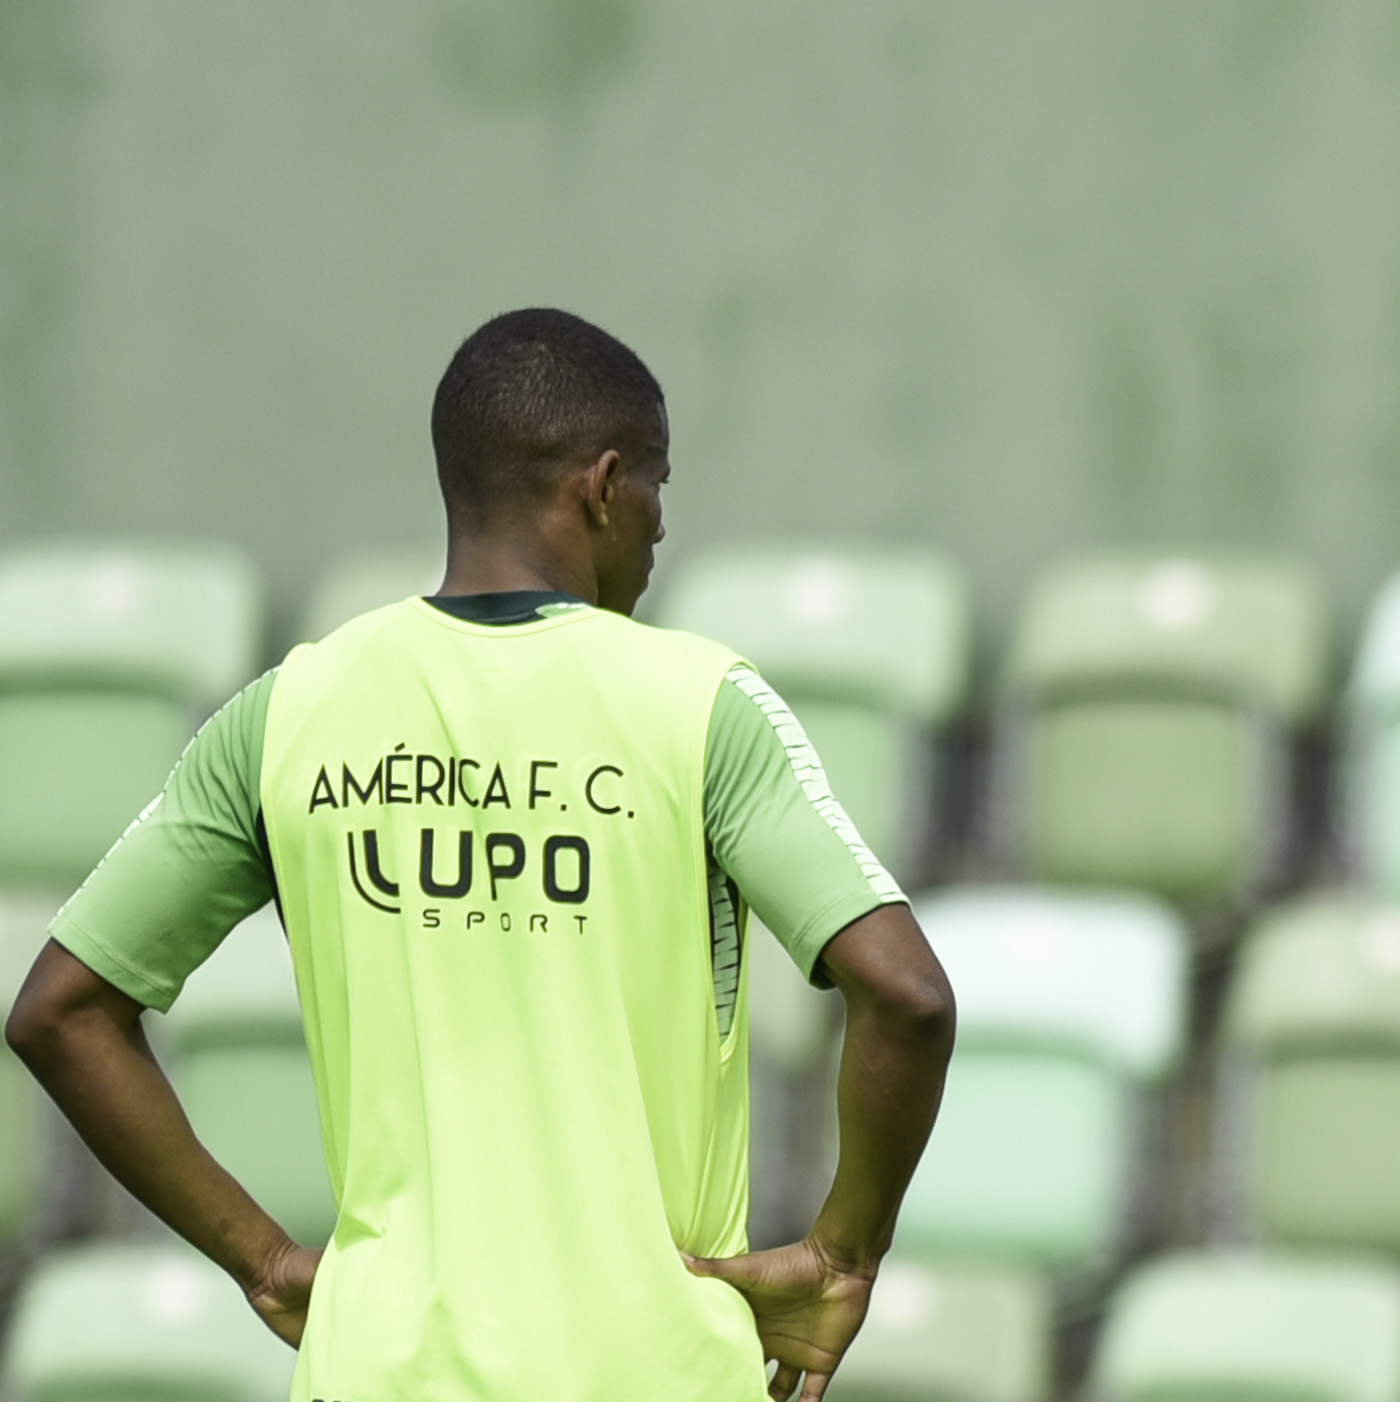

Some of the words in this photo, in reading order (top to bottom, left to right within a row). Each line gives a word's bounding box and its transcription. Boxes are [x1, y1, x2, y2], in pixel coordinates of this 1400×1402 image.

[308, 742, 511, 815] AMÉRICA
[347, 828, 590, 914] LUPO
[422, 908, 588, 935] SPORT
